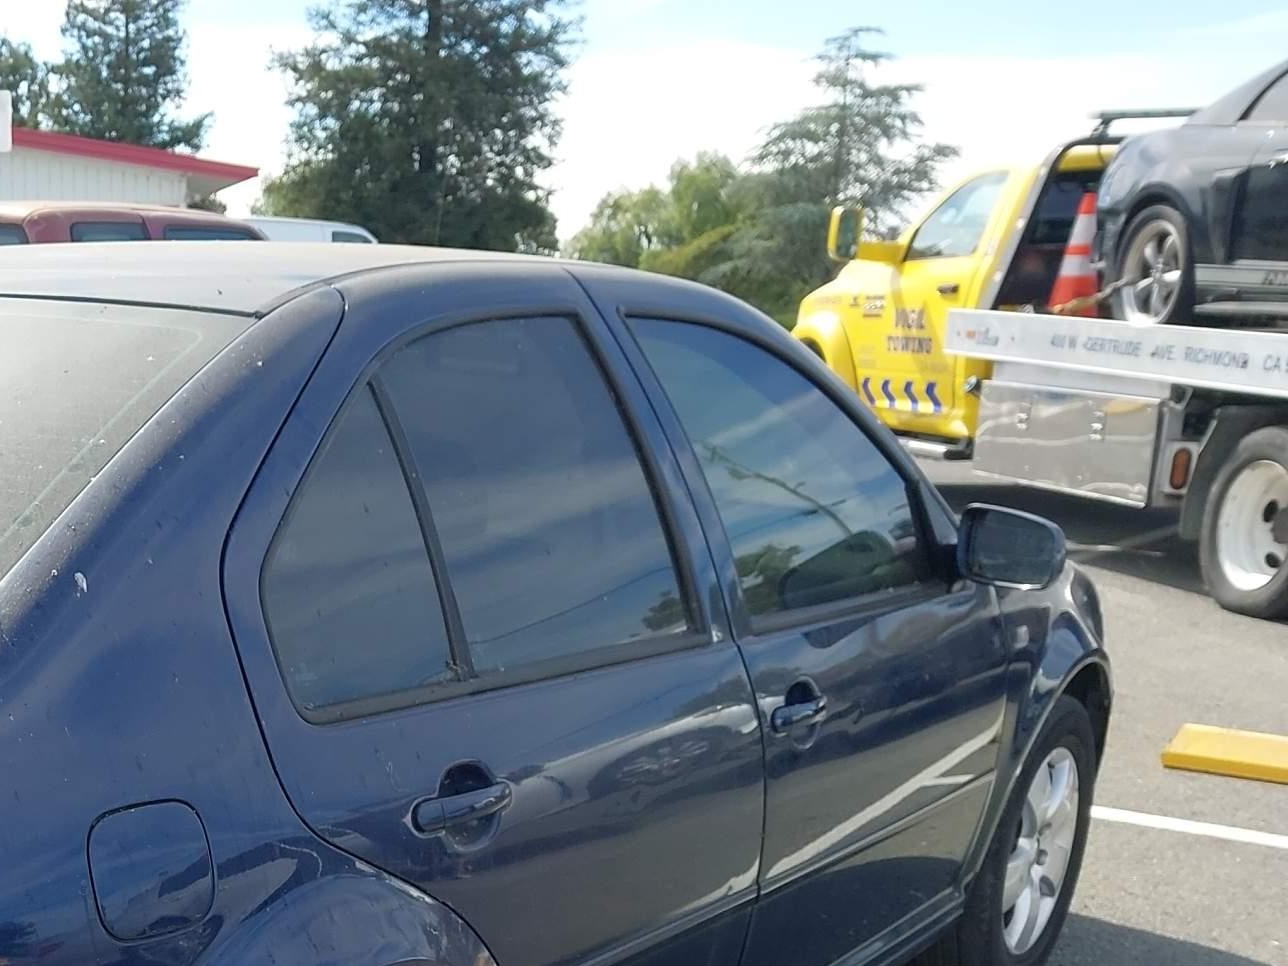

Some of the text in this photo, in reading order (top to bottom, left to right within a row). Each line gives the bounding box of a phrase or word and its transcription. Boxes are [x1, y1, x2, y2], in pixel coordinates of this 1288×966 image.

[1150, 345, 1176, 360] AVE
[1184, 346, 1249, 369] RICHMOND
[1263, 354, 1281, 371] CA
